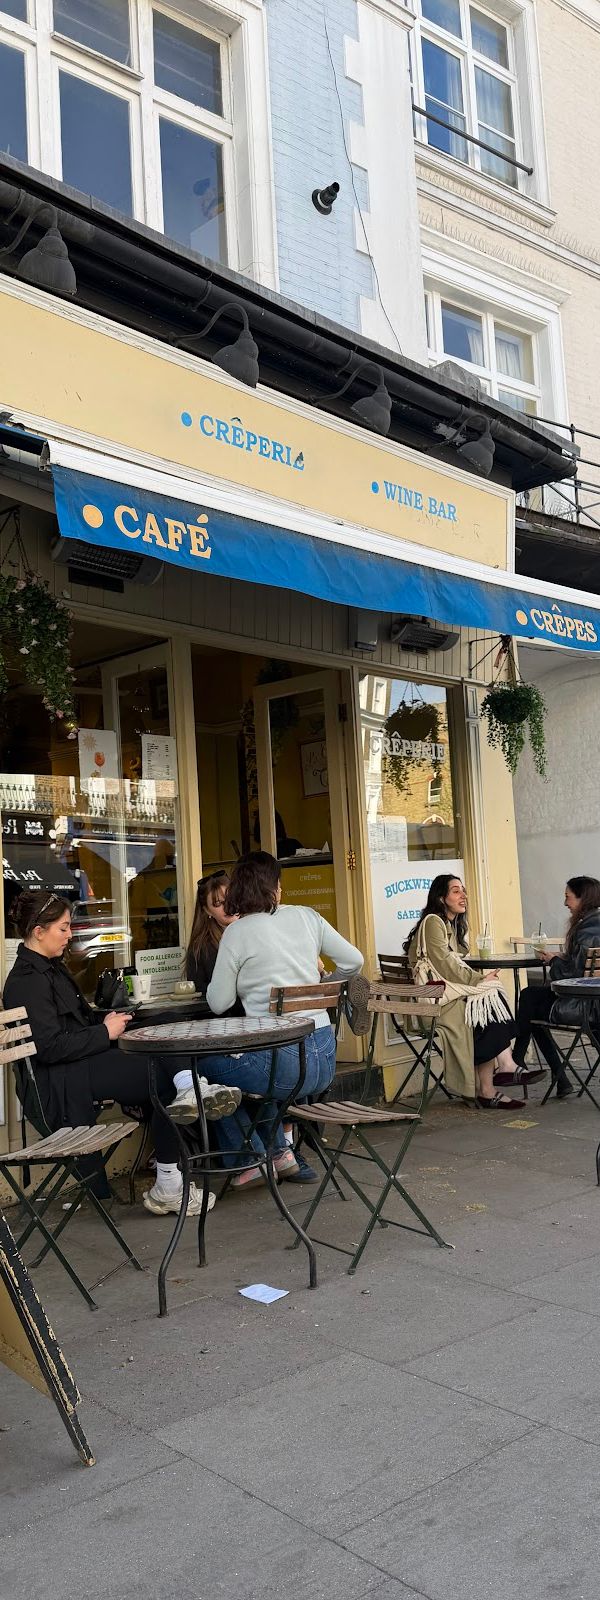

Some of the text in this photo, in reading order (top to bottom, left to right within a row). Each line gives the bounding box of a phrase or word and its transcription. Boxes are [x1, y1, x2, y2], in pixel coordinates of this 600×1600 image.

[383, 480, 458, 521] WINE BAR
[113, 504, 212, 559] CAFÉ
[530, 604, 598, 643] CRÊPES
[370, 731, 446, 763] CRÊPERIE
[384, 878, 434, 898] BUCKWH
[397, 909, 422, 920] SARR
[155, 952, 182, 961] ALLERGIES
[142, 965, 181, 975] INTOLERANCES
